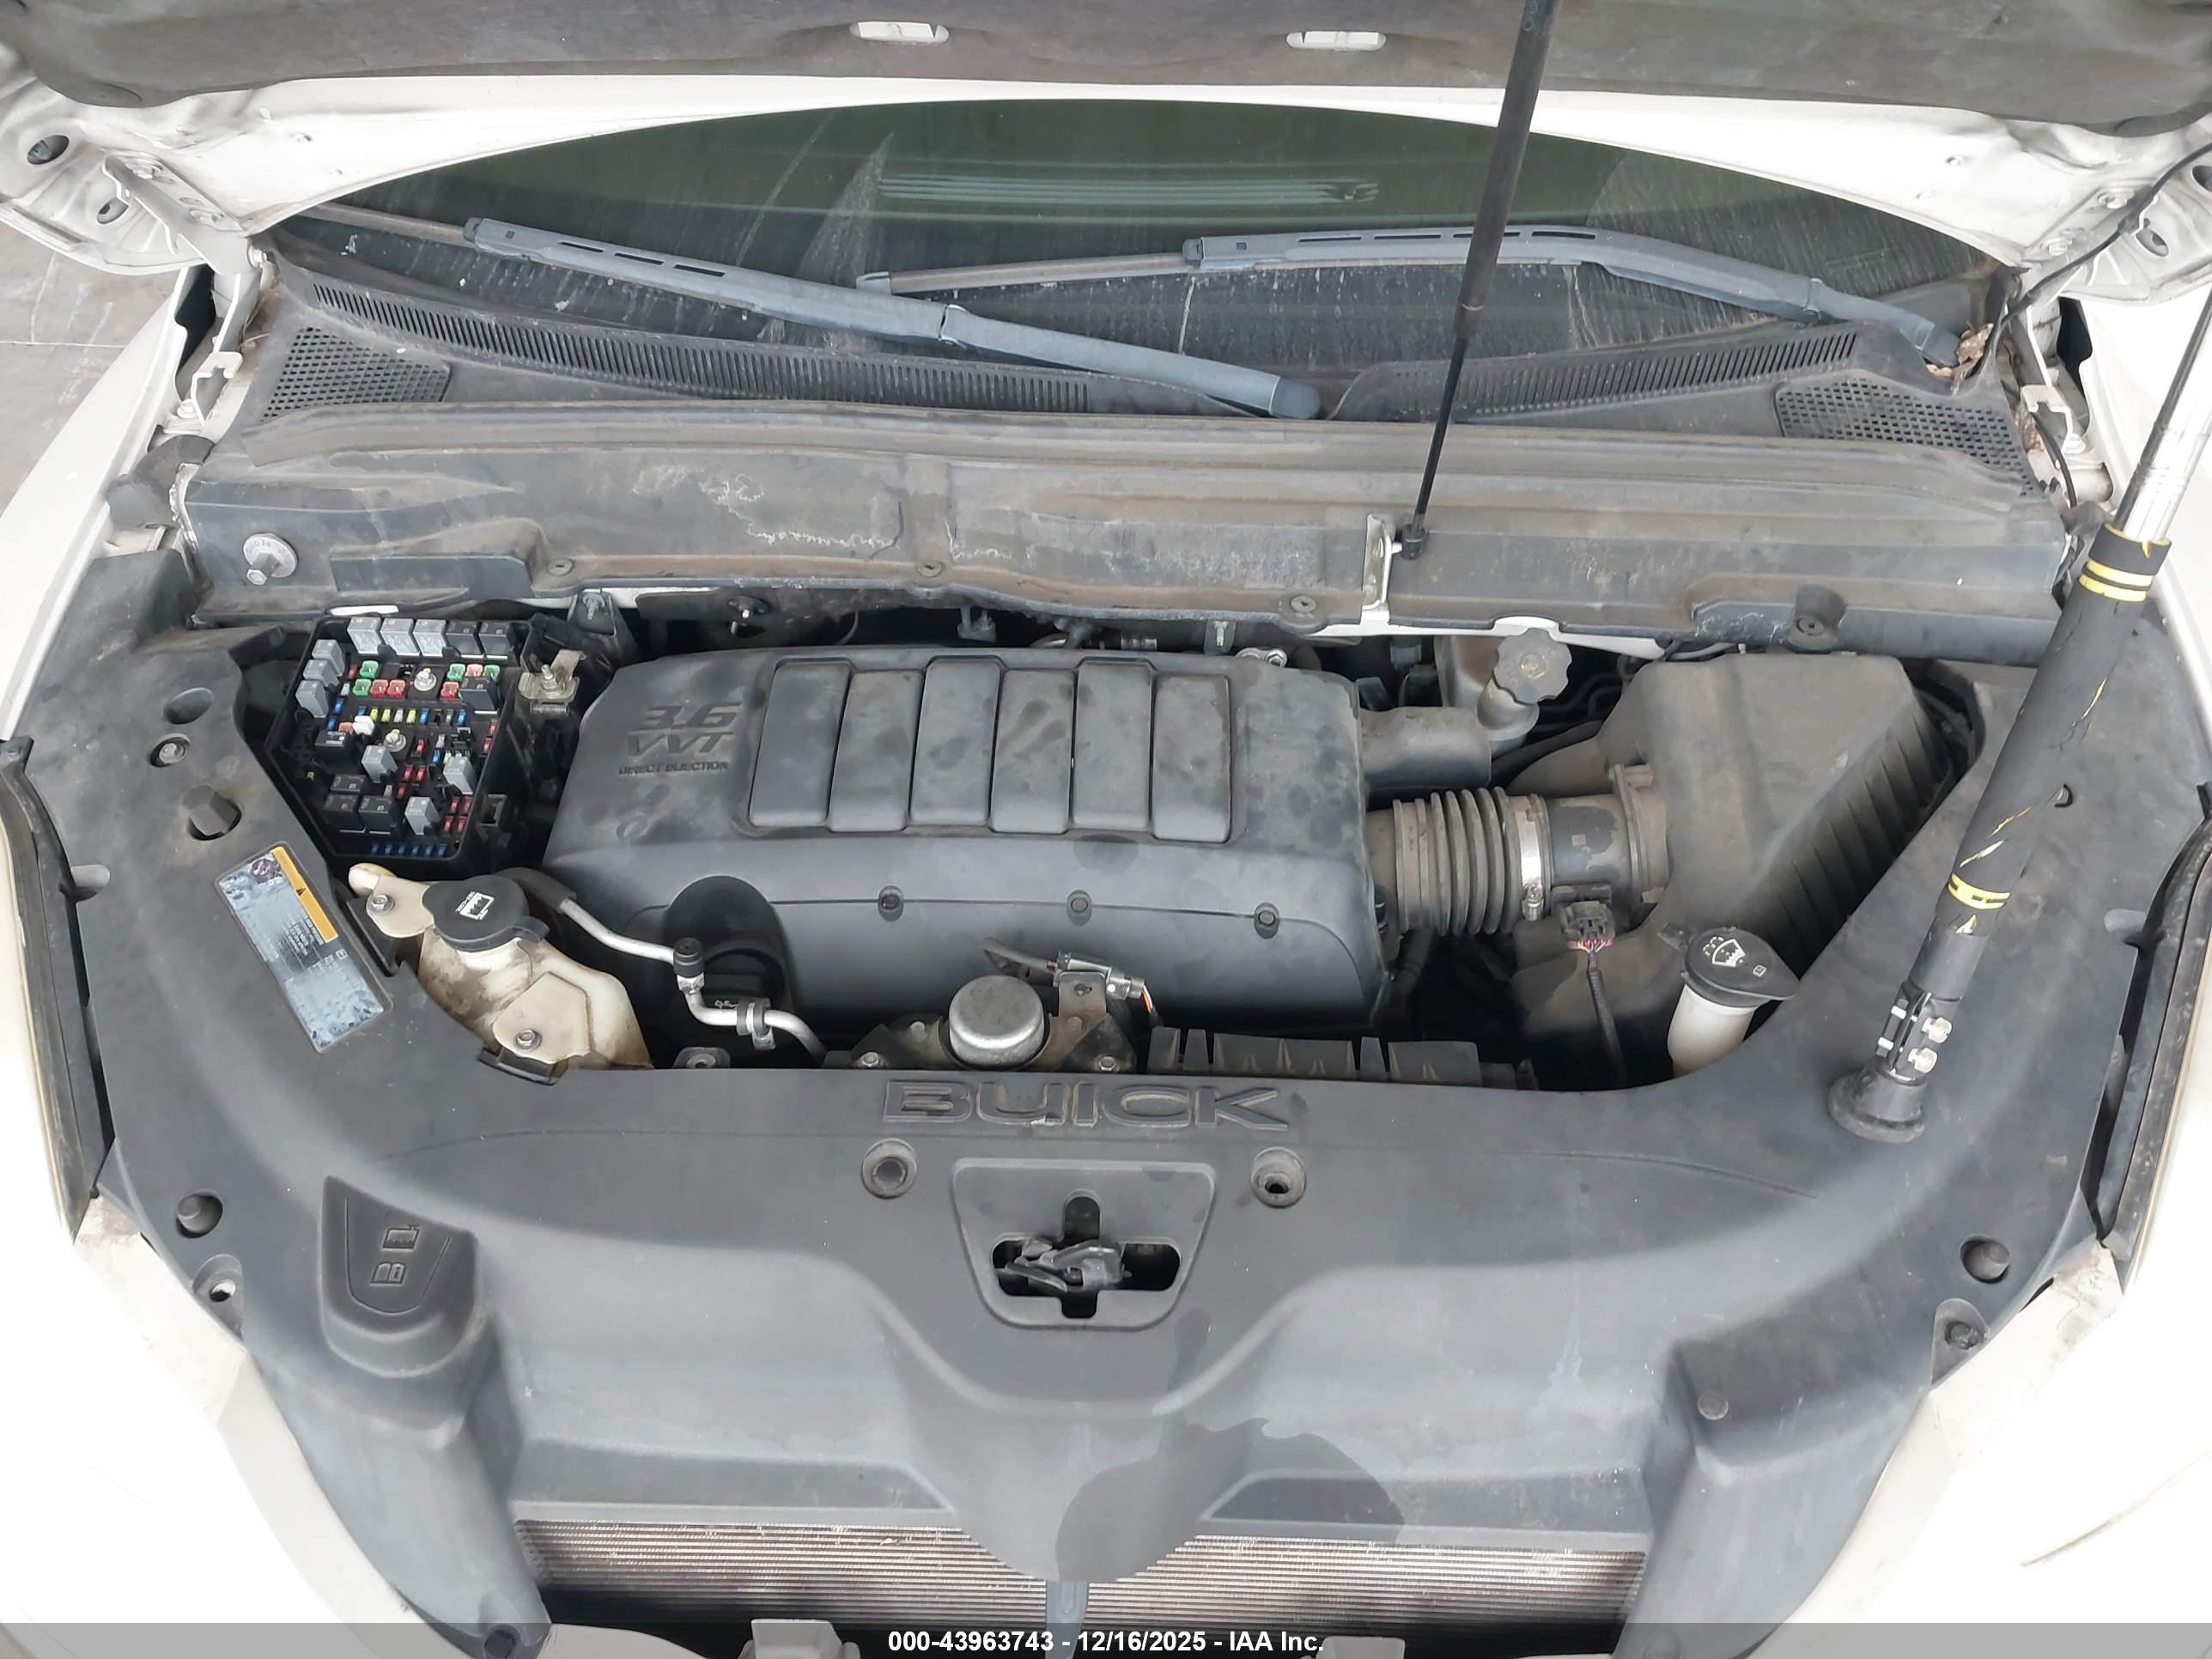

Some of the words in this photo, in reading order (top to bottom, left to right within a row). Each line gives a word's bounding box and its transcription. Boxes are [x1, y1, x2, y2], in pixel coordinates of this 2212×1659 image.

[640, 702, 743, 730] 3.6
[627, 731, 734, 757] VVT
[882, 1079, 1290, 1131] BUICK
